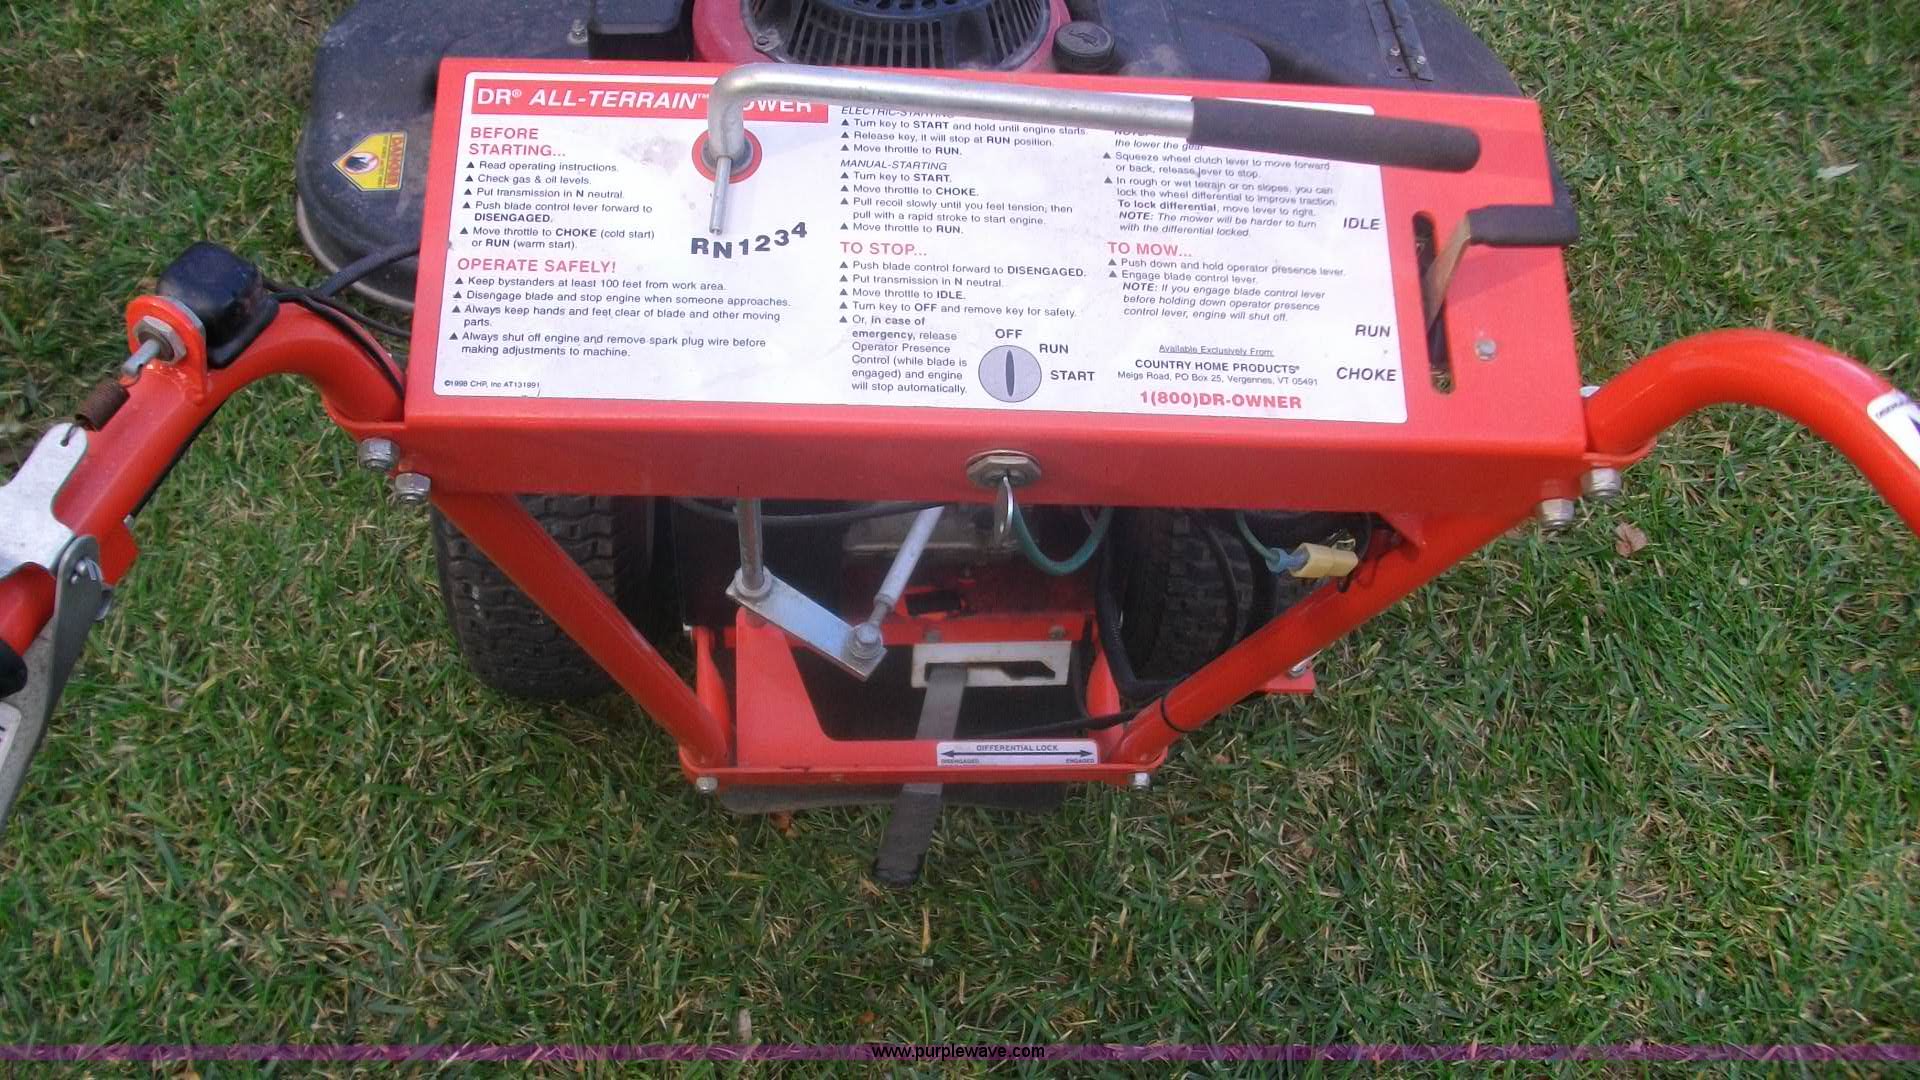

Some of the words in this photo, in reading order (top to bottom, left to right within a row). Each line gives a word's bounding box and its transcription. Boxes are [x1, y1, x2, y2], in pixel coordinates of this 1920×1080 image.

[742, 100, 812, 113] WER
[470, 127, 540, 139] BEFORE
[479, 160, 507, 169] Read
[508, 161, 557, 172] operating
[839, 158, 948, 171] MANUAL-STARTING
[477, 174, 510, 183] Check
[512, 176, 532, 185] gas
[544, 175, 557, 184] oil
[853, 172, 877, 181] Turn
[879, 172, 898, 183] key
[900, 173, 911, 181] to
[476, 187, 494, 196] Put
[496, 188, 561, 197] transmission
[563, 189, 573, 197] in
[575, 189, 585, 198] N
[853, 184, 882, 194] Move
[884, 185, 920, 194] throttle
[922, 186, 933, 195] to
[475, 201, 502, 210] Push
[503, 201, 533, 210] blade
[534, 202, 571, 211] control
[572, 203, 599, 211] lever
[601, 203, 641, 212] forward
[642, 204, 653, 213] to
[1343, 217, 1382, 230] IDLE
[472, 226, 501, 235] Move
[503, 227, 539, 236] throttle
[541, 227, 553, 236] to
[555, 227, 598, 237] CHOKE
[600, 228, 626, 239] (cold
[628, 229, 655, 239] start)
[471, 239, 483, 247] or
[485, 238, 511, 247] RUN
[513, 238, 546, 249] (warm
[839, 241, 864, 254] TO
[1106, 242, 1131, 255] TO
[457, 257, 539, 271] OPERATE
[543, 259, 617, 273] SAFELY!
[852, 260, 880, 270] Push
[882, 261, 911, 271] blade
[913, 262, 950, 272] control
[951, 263, 991, 273] forward
[993, 264, 1005, 274] to
[1120, 258, 1148, 268] Push
[1149, 259, 1178, 269] down
[1179, 260, 1201, 270] and
[1201, 261, 1225, 271] hold
[1226, 262, 1269, 275] operator
[1121, 269, 1161, 282] Engage
[1163, 271, 1193, 281] blade
[1194, 272, 1229, 282] control
[467, 276, 496, 287] Keep
[497, 276, 555, 289] bystanders
[557, 278, 569, 287] at
[571, 278, 597, 287] least
[600, 279, 620, 288] 100
[621, 279, 643, 288] feet
[645, 280, 669, 289] from
[671, 280, 697, 290] work
[851, 301, 877, 311] Turn
[879, 302, 899, 314] key
[900, 302, 912, 312] to
[913, 303, 938, 313] OFF
[940, 304, 961, 313] and
[963, 306, 1003, 315] remove
[1005, 305, 1025, 317] key
[1027, 306, 1042, 316] for
[871, 315, 882, 324] in
[884, 317, 912, 325] case
[913, 316, 926, 325] of
[919, 330, 958, 340] release
[994, 328, 1024, 339] OFF
[1354, 323, 1391, 337] RUN
[461, 331, 499, 343] Always
[501, 332, 525, 342] shut
[527, 333, 542, 342] off
[543, 333, 581, 345] engine
[583, 334, 605, 343] and
[606, 336, 646, 344] remove
[648, 335, 679, 347] spark
[681, 336, 705, 347] plug
[707, 336, 730, 346] wire
[732, 337, 767, 347] before
[461, 344, 500, 356] making
[501, 345, 567, 357] adjustments
[569, 346, 581, 355] to
[851, 341, 899, 353] Operator
[901, 342, 951, 352] Presence
[1039, 343, 1069, 354] RUN
[1200, 346, 1248, 357] Exclusively
[851, 355, 891, 365] Control
[893, 356, 925, 367] (while
[926, 356, 956, 366] blade
[958, 357, 968, 366] is
[1134, 359, 1192, 370] COUNTRY
[1194, 361, 1230, 371] HOME
[851, 368, 903, 380] engaged)
[904, 369, 925, 379] and
[927, 370, 963, 382] engine
[1050, 370, 1096, 381] START
[1174, 372, 1190, 381] PO
[1191, 372, 1209, 381] Box
[1277, 375, 1290, 384] VT
[1336, 367, 1397, 381] CHOKE
[851, 381, 869, 391] will
[871, 382, 895, 394] stop
[1140, 391, 1302, 409] 1(800)DR-OWNER
